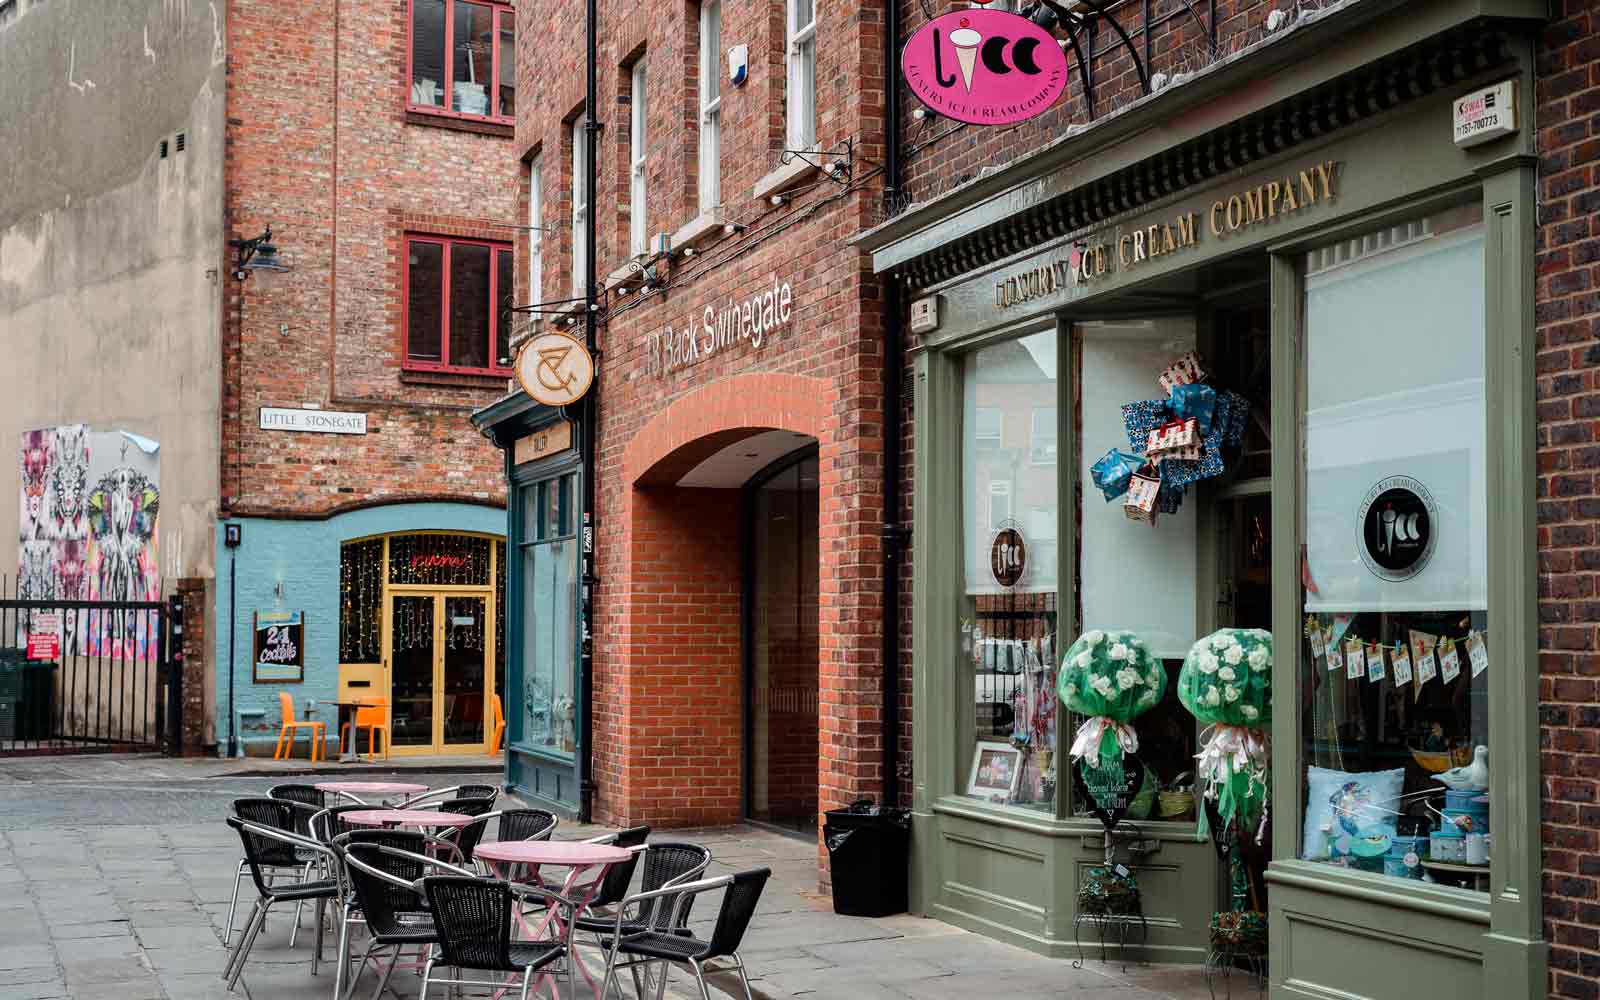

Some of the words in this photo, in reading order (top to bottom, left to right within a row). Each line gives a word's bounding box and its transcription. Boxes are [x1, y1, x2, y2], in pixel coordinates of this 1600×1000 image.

[992, 262, 1061, 310] LUXURY
[1119, 211, 1197, 267] CREAM
[1209, 160, 1336, 239] COMPANY
[663, 313, 699, 371] Back
[704, 276, 791, 354] Swinegate
[264, 413, 297, 425] LITTLE
[305, 414, 364, 429] STONEGATE
